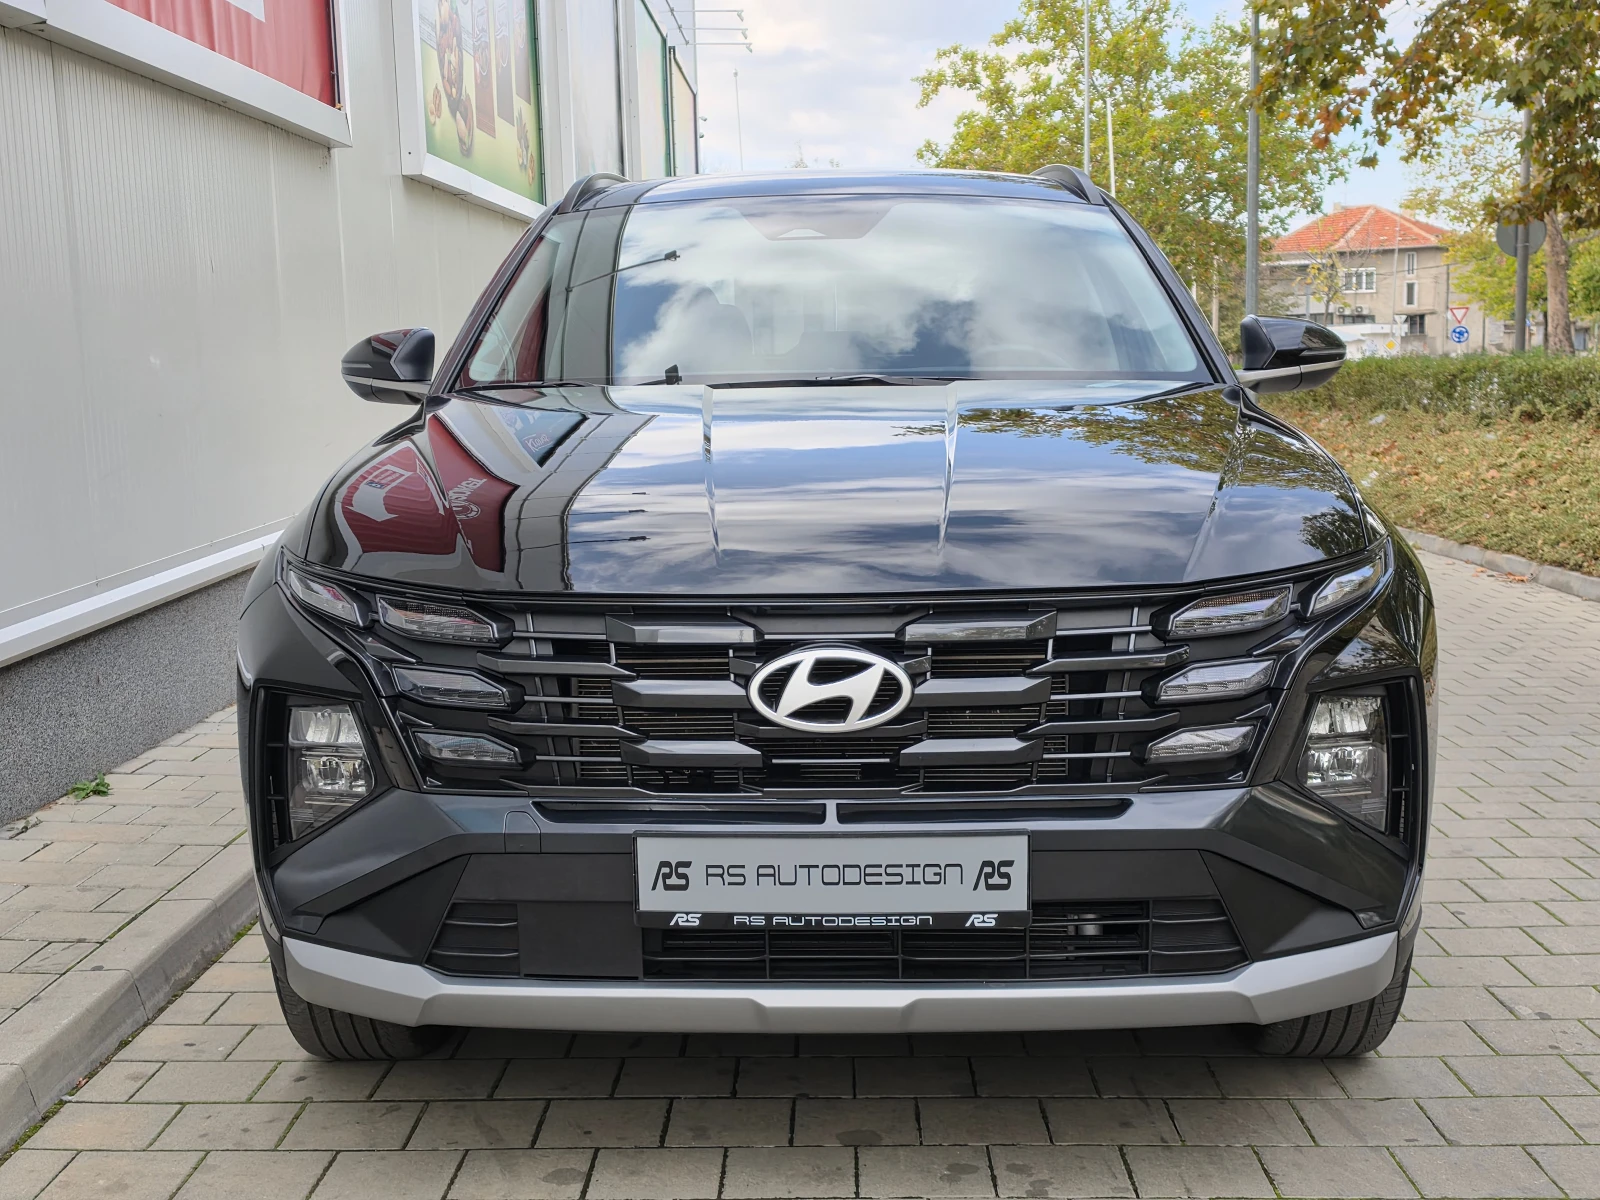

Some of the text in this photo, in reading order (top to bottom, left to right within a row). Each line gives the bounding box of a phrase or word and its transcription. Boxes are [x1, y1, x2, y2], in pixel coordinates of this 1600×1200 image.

[651, 859, 1015, 892] RS RS AUTODESIGN RS
[669, 913, 998, 927] RS RS AUTODESIGN RS
